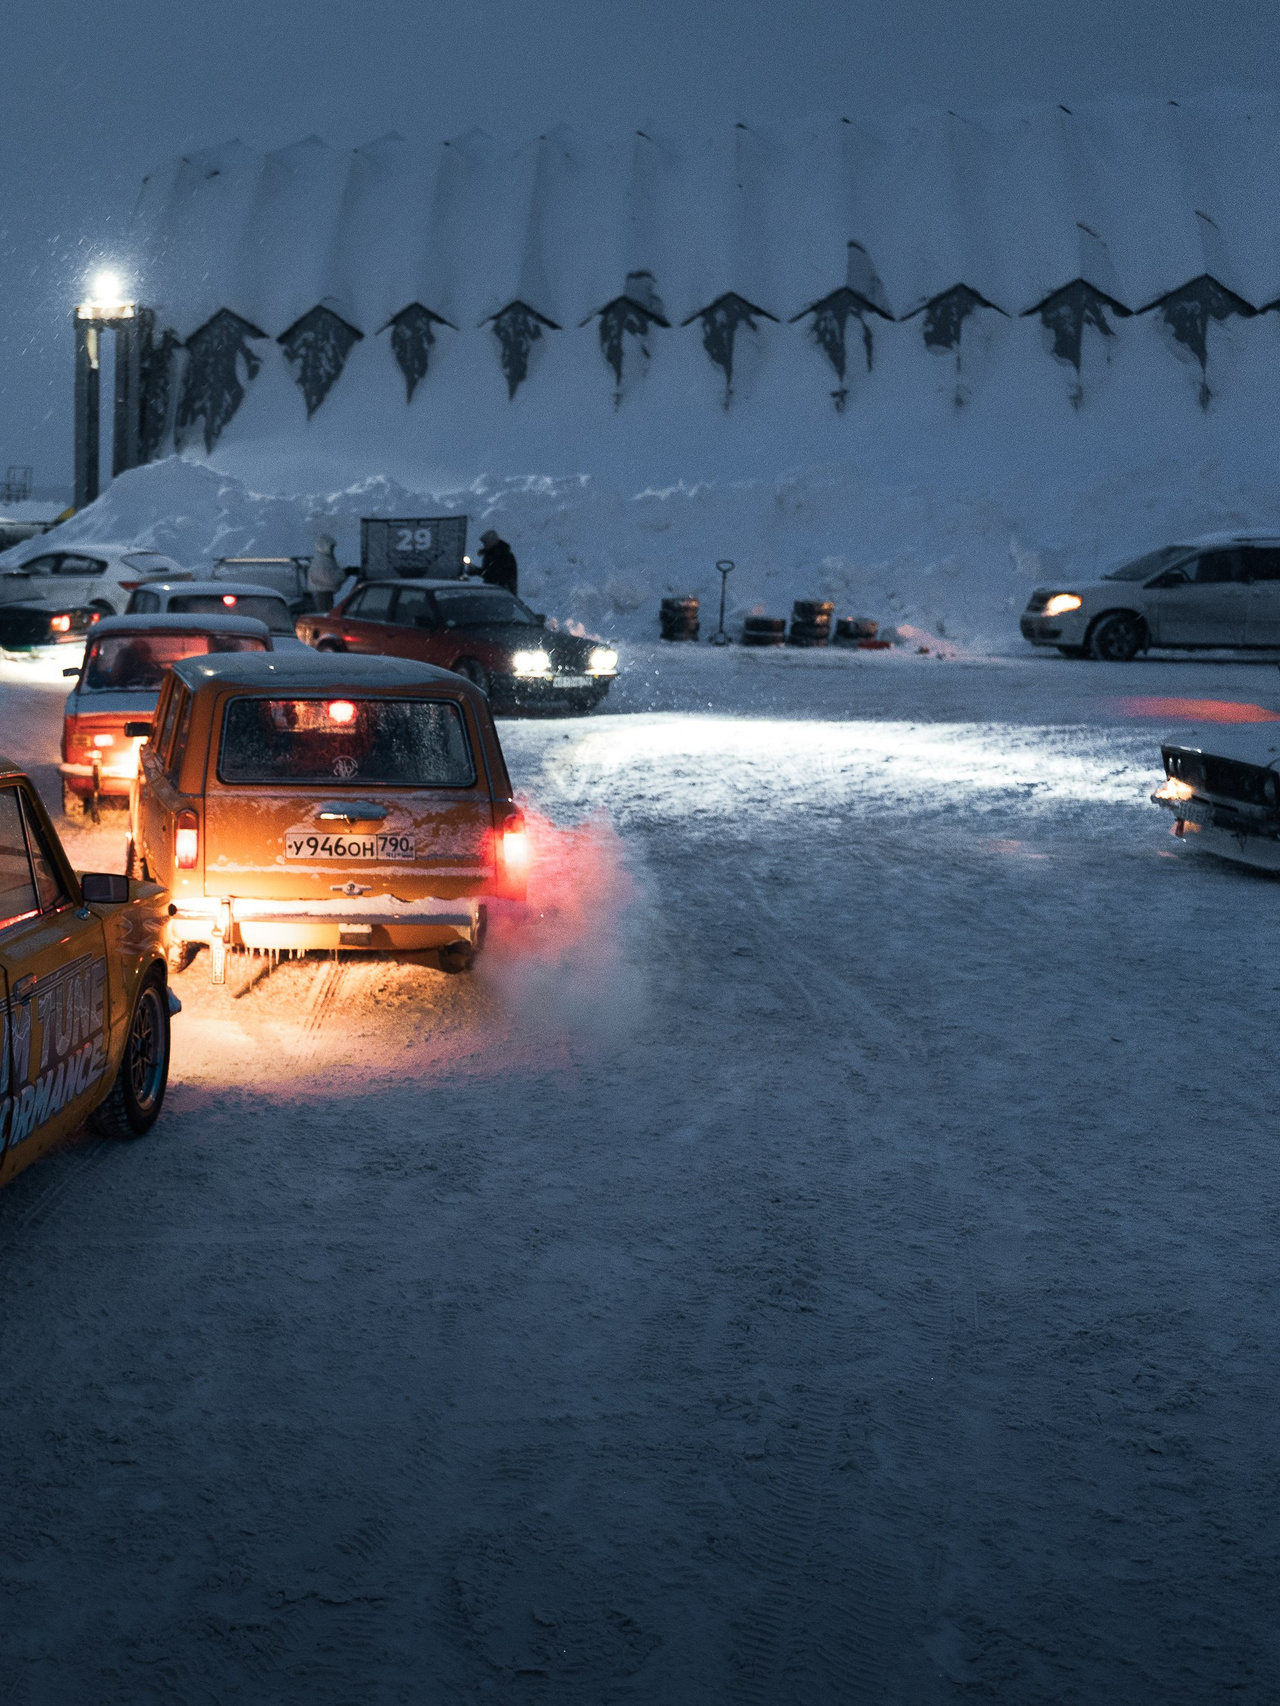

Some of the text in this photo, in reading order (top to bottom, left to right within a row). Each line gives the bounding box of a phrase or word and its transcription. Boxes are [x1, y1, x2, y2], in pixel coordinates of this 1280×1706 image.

[395, 528, 432, 551] 29
[378, 836, 410, 852] 790
[37, 955, 106, 1073] TUNE
